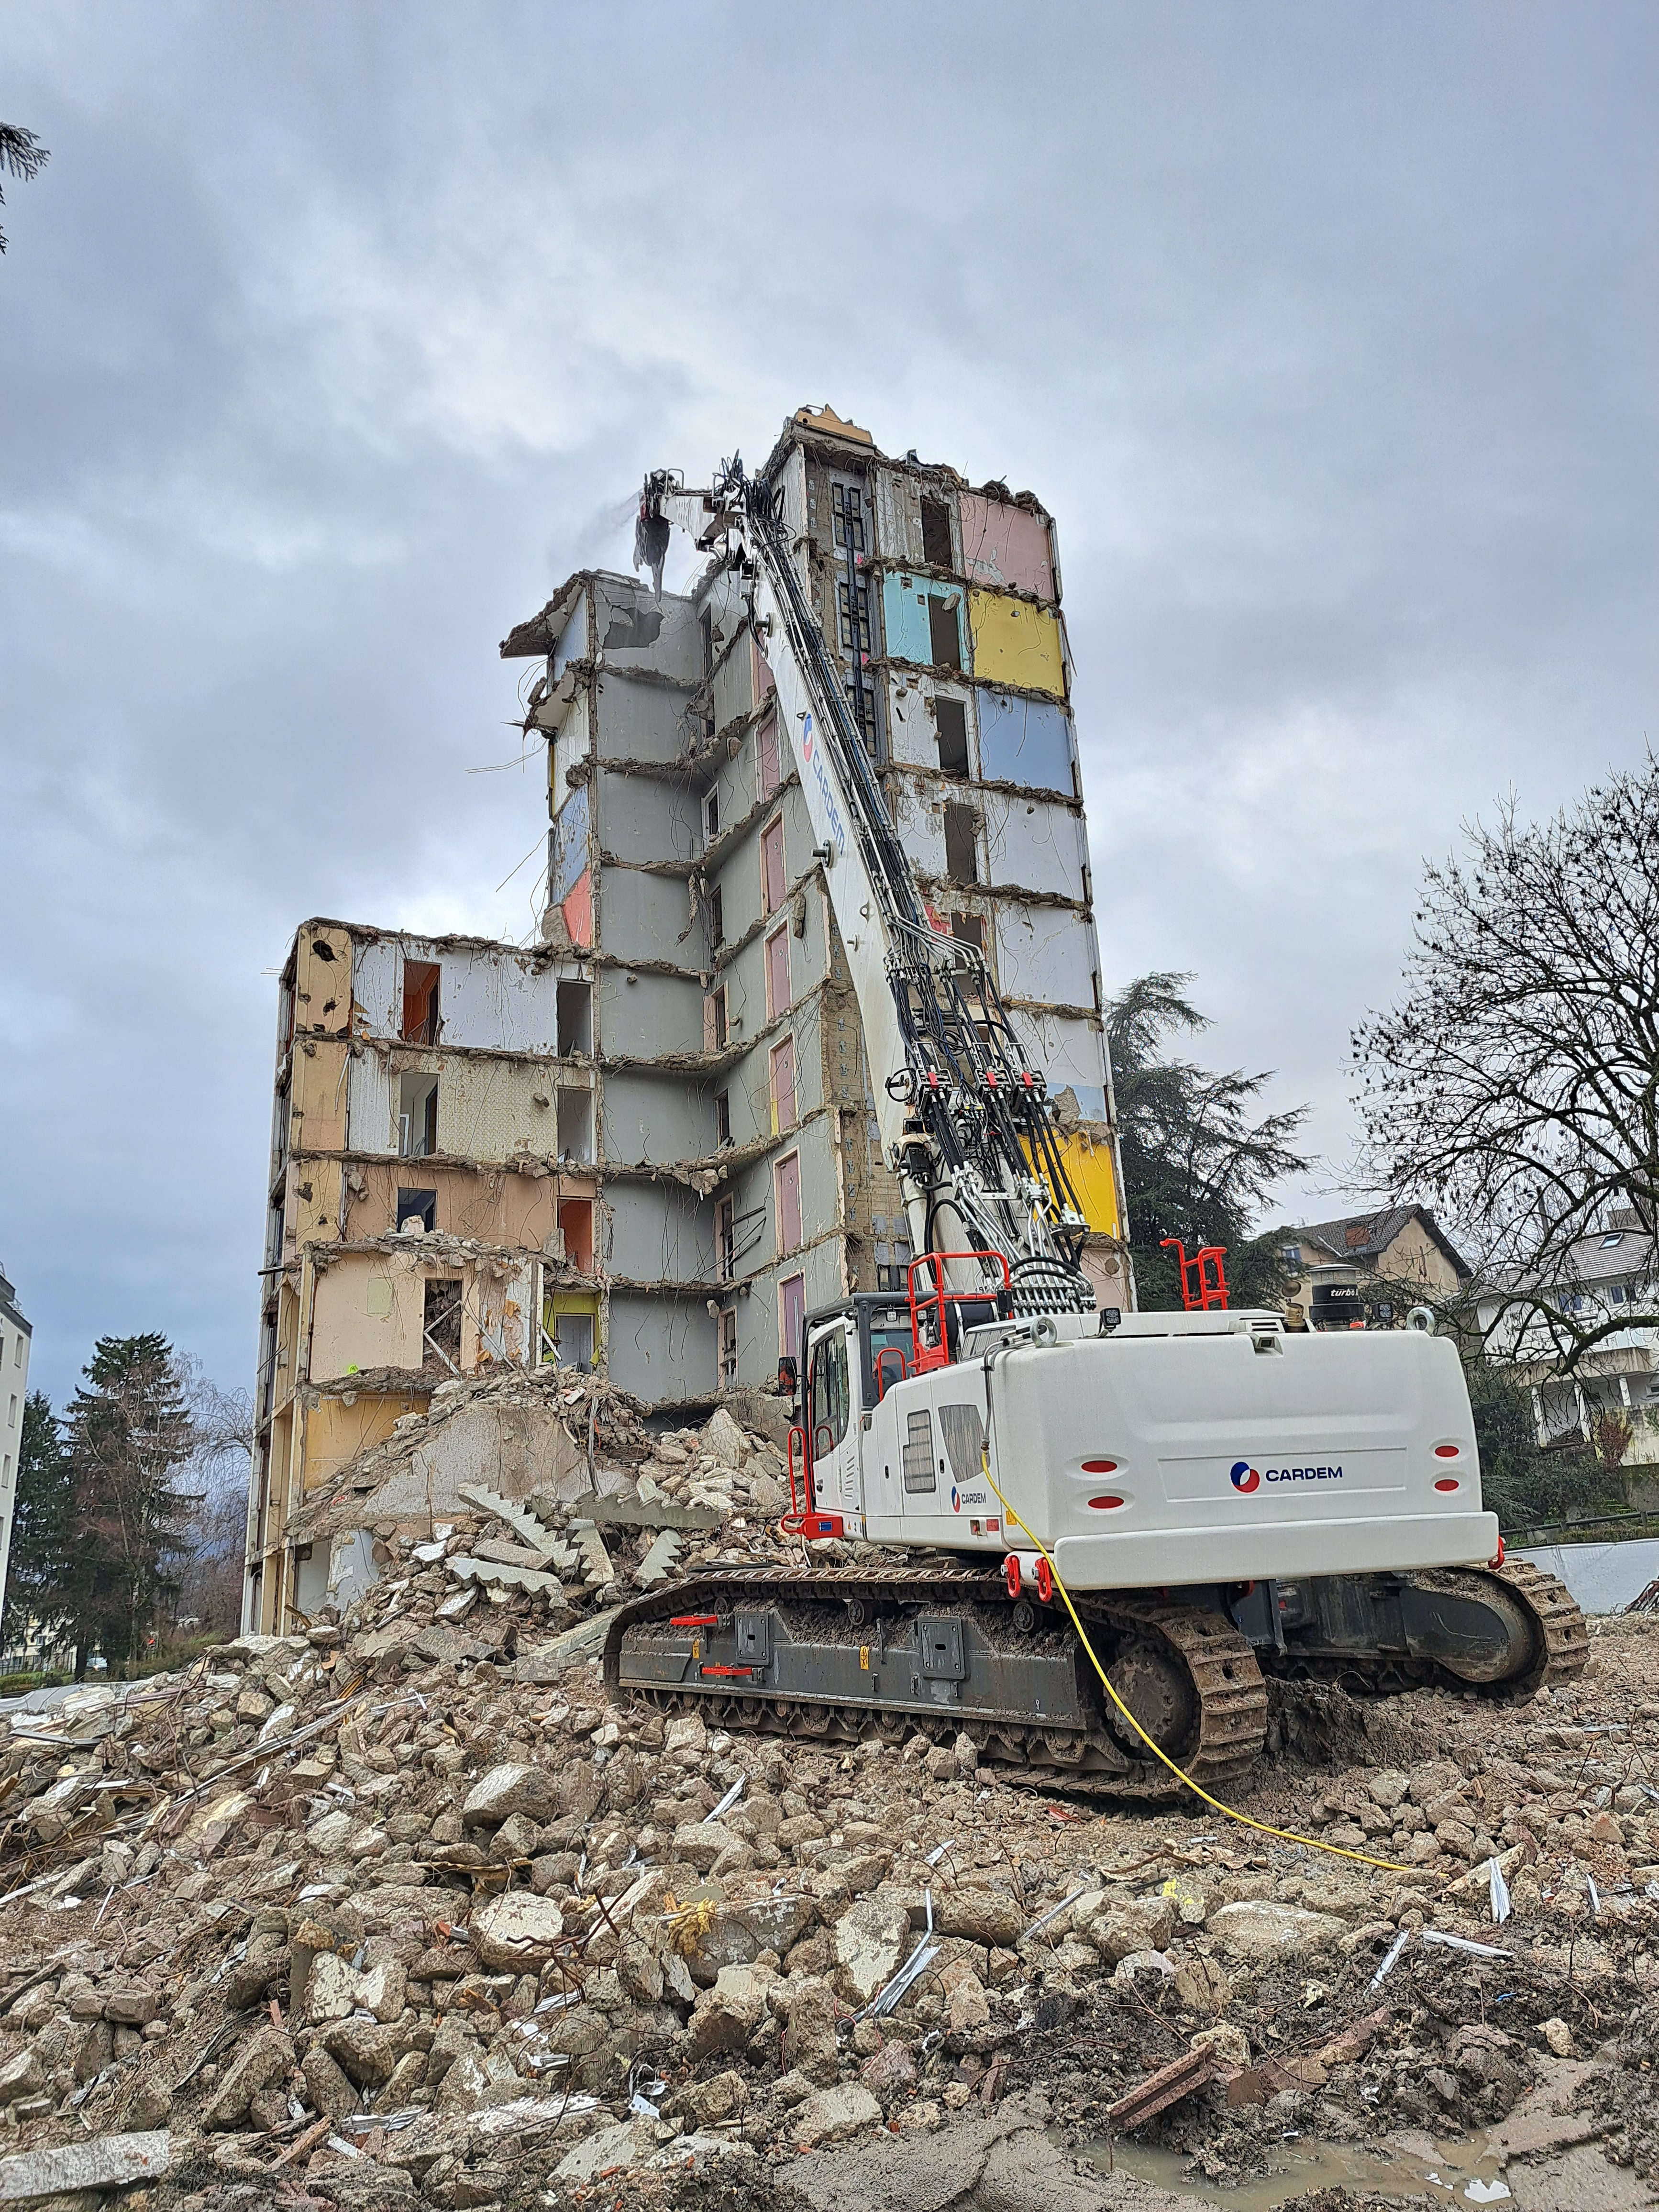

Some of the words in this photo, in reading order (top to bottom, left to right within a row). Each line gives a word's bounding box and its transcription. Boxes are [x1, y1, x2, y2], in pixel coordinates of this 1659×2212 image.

[813, 749, 845, 856] CARDEM
[1266, 1466, 1343, 1482] CARDEM
[961, 1492, 986, 1504] CARDEM
